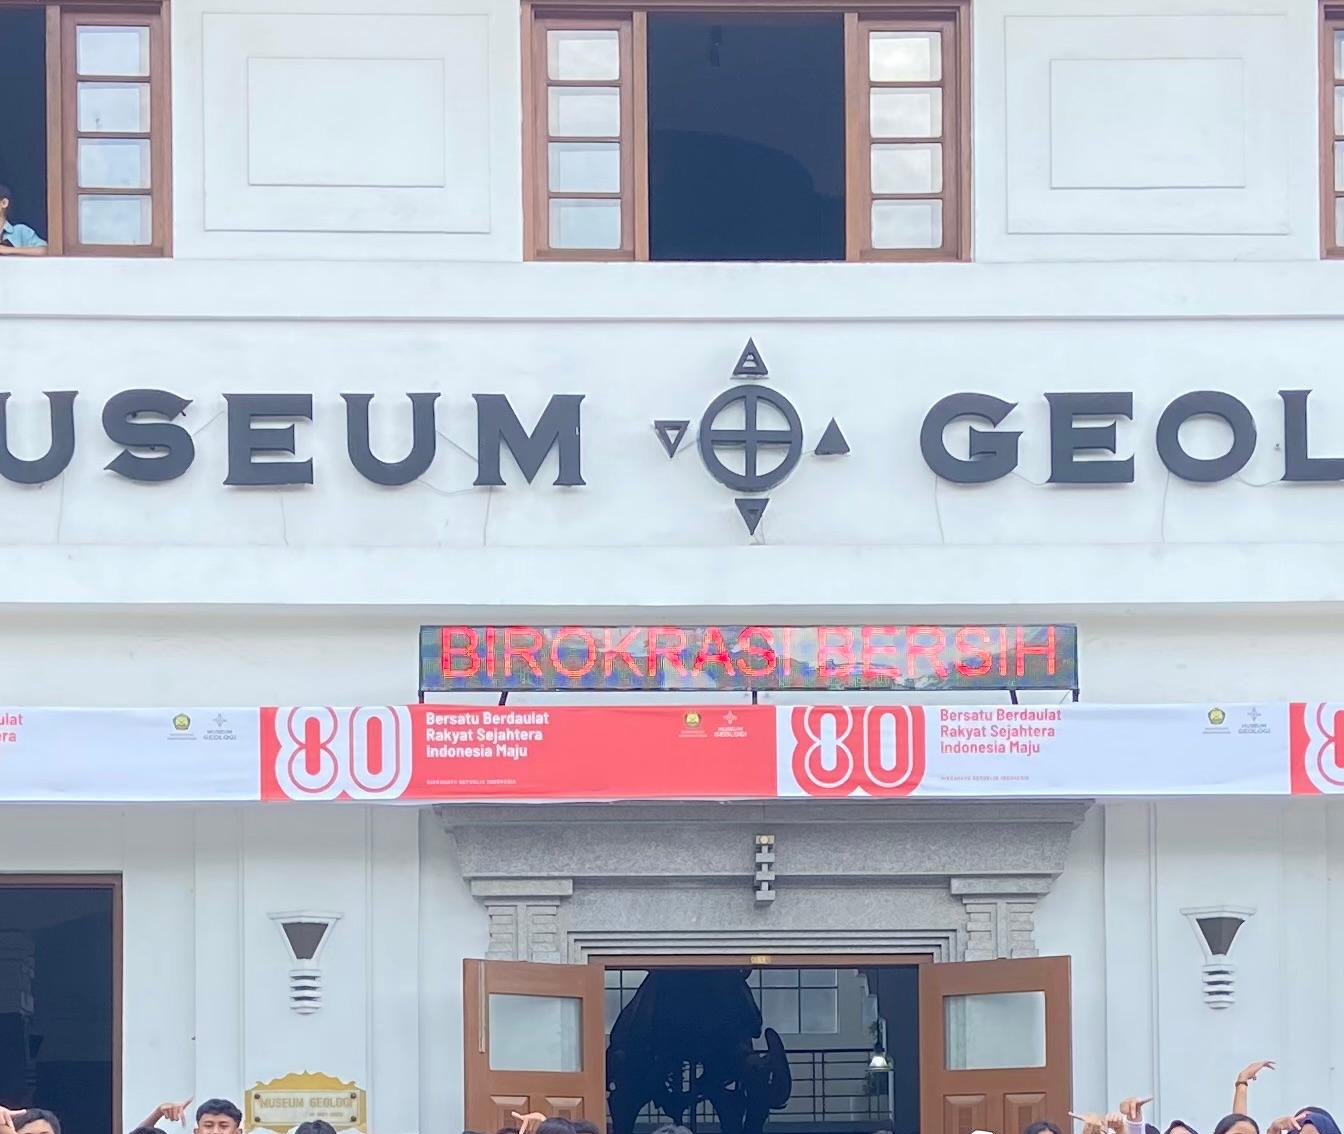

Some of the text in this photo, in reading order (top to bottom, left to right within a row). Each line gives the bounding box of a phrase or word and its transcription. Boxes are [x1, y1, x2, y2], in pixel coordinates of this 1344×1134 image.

[440, 625, 1056, 679] BIROKRASI BERSIH
[426, 711, 549, 725] Bersatu Berdaulat
[940, 708, 1062, 721] Bersatu Berdaulat
[426, 728, 543, 744] Rakyat Sejahtera
[940, 725, 1055, 741] Rakyat Sejahtera
[275, 705, 413, 800] 80
[426, 744, 528, 761] Indonesia Maju
[791, 705, 926, 796] 80
[940, 741, 1041, 757] Indonesia Maju
